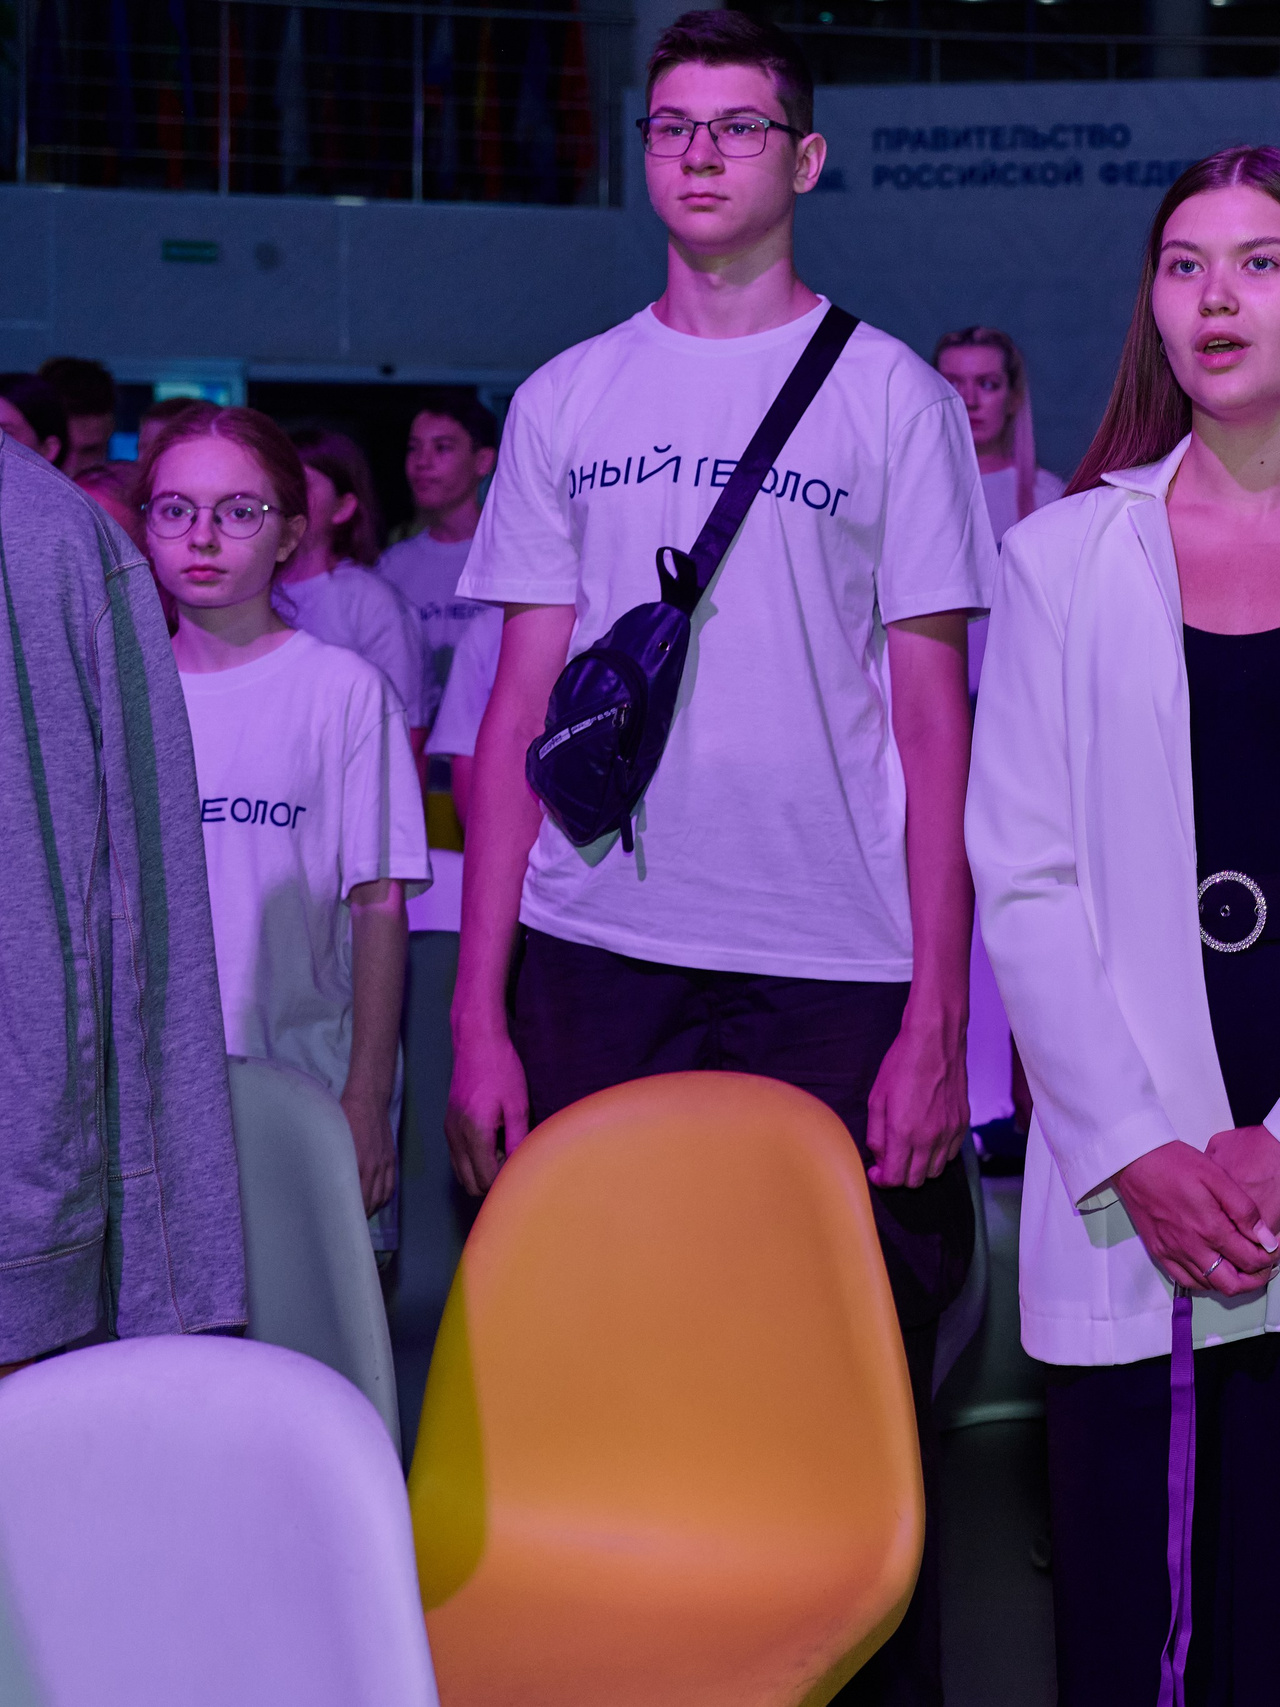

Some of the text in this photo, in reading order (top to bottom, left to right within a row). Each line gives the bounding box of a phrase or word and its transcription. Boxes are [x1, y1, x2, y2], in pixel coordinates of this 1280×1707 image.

[872, 123, 1132, 153] ПРАВИТЕЛЬСТВО
[872, 157, 1198, 190] РОССИЙСКОЙ ФЕДЕ
[201, 797, 306, 829] ЕОЛОГ
